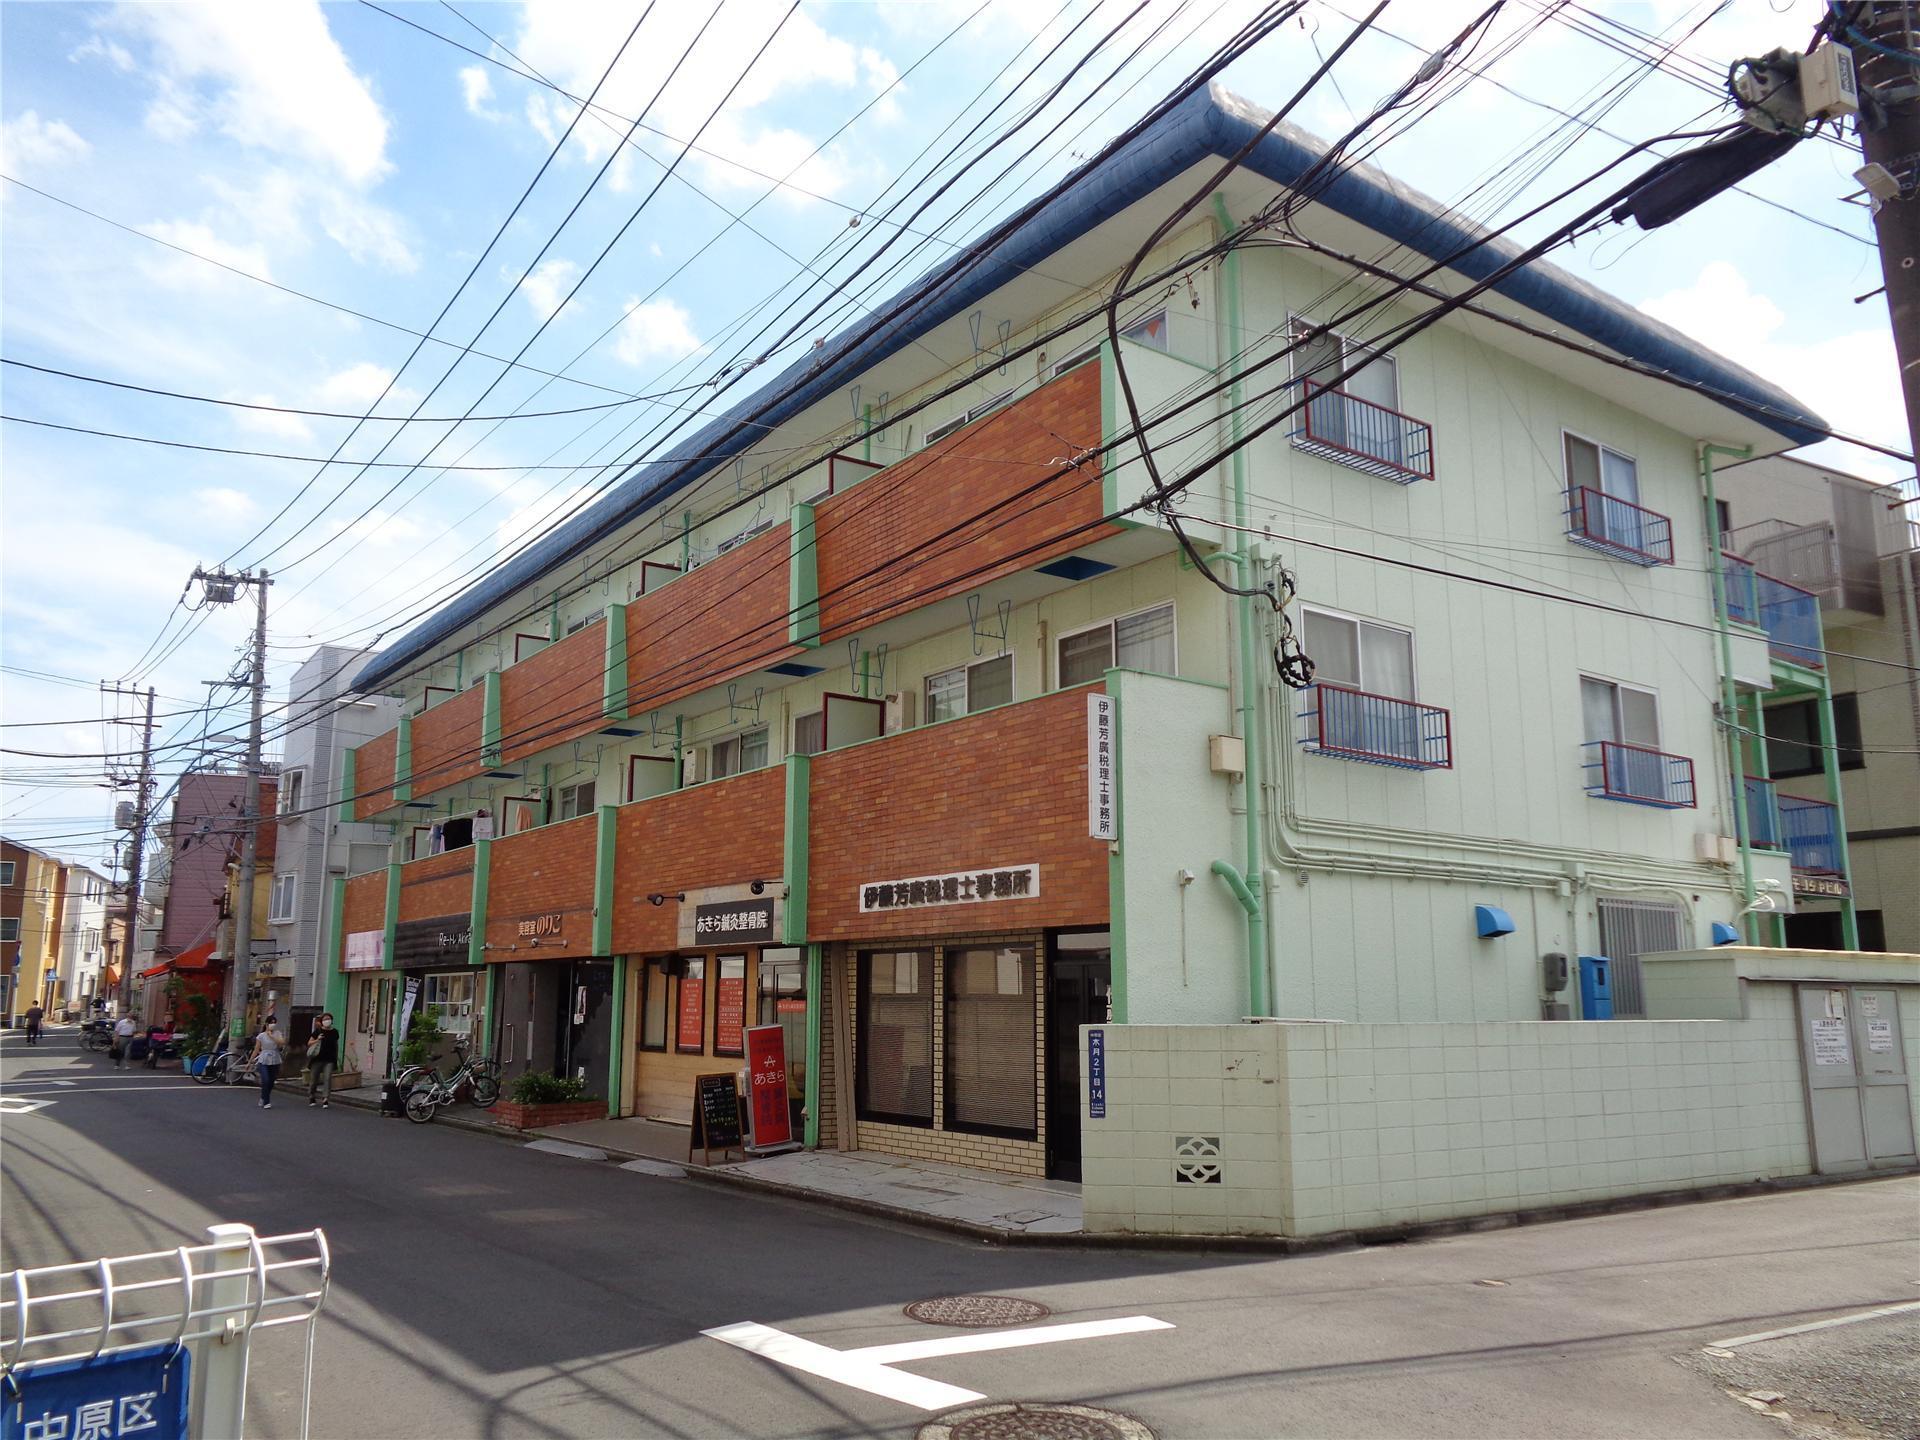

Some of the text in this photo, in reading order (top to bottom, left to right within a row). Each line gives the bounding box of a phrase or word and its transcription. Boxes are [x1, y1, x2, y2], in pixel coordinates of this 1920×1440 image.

[1098, 700, 1110, 833] 伊藤芳廣税理士事務所
[696, 909, 769, 933] あきら鍼灸整骨院
[754, 1070, 785, 1085] あきら
[24, 1391, 158, 1440] 中原区
